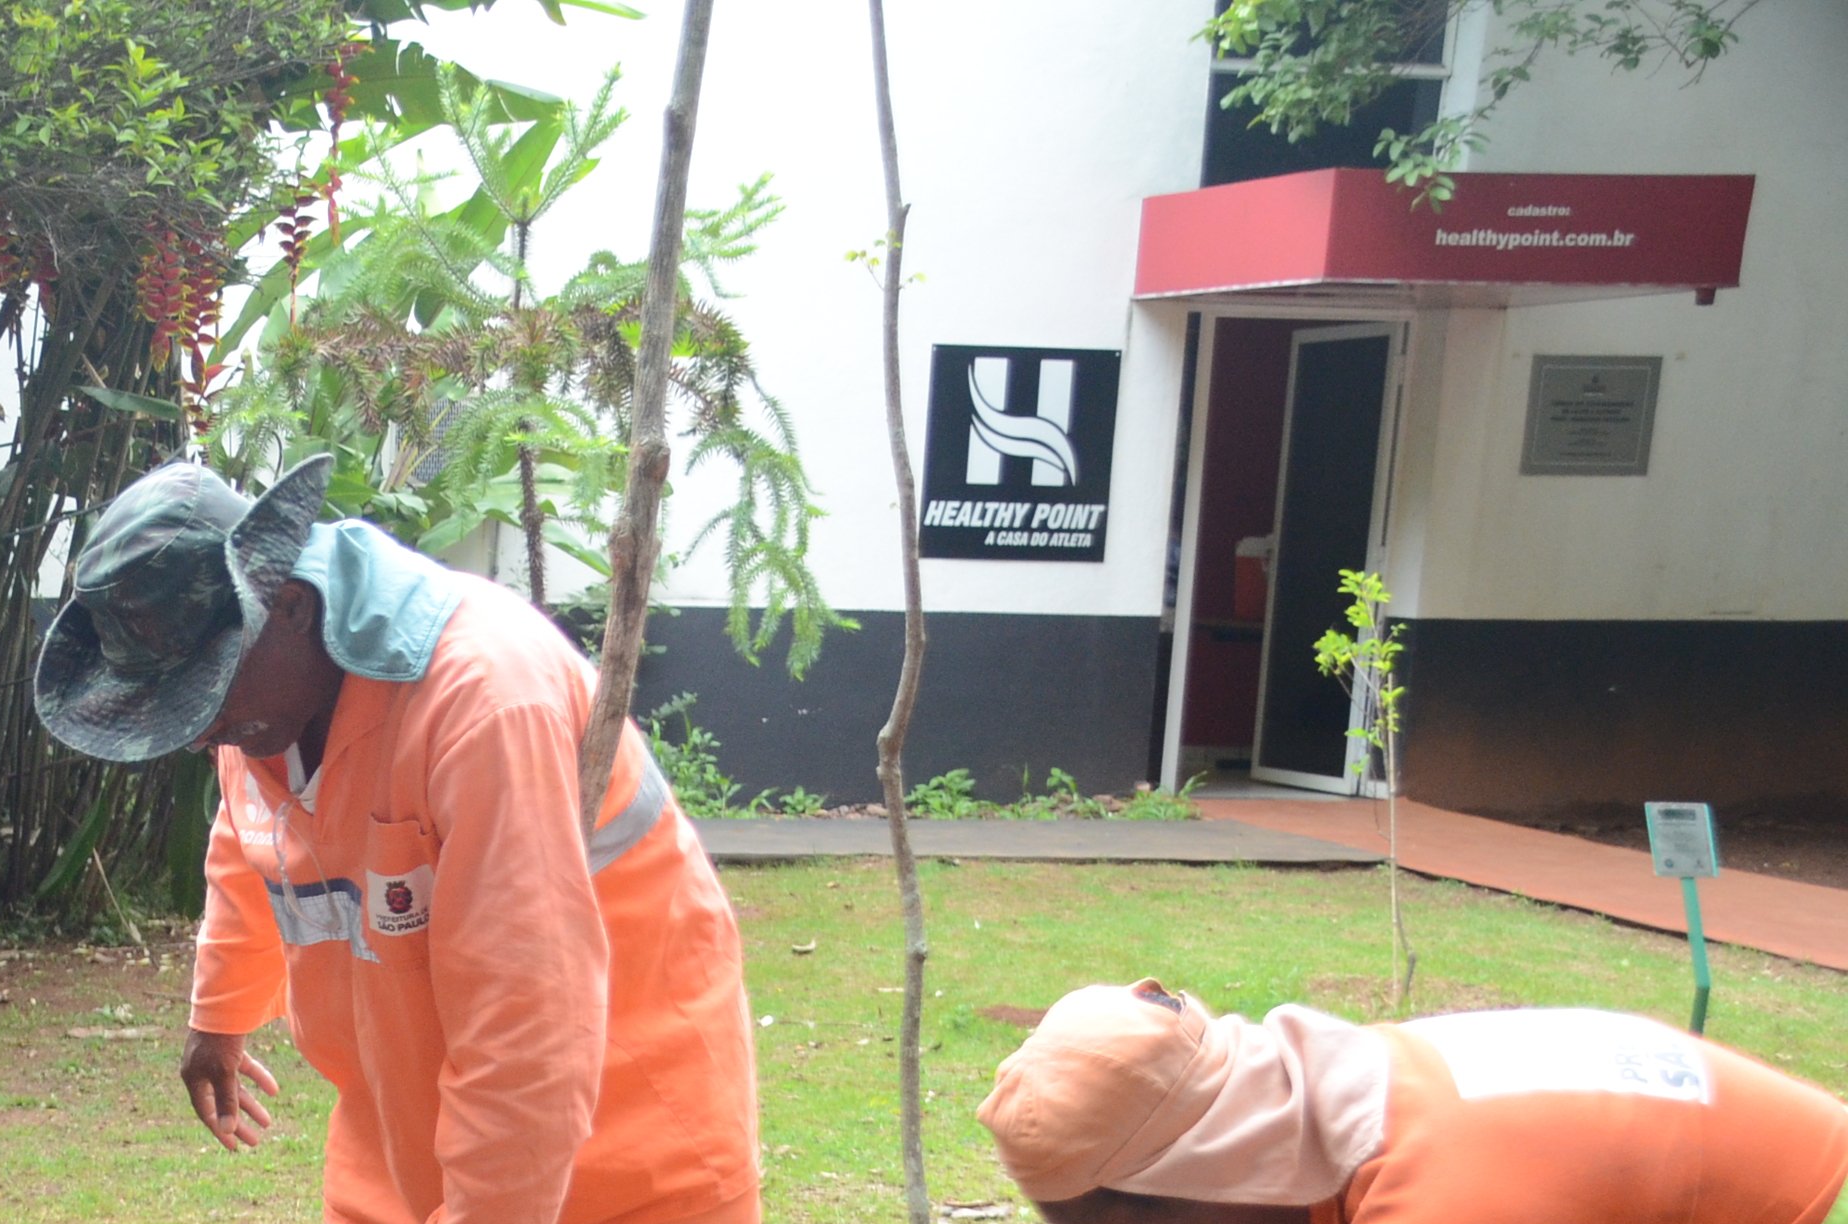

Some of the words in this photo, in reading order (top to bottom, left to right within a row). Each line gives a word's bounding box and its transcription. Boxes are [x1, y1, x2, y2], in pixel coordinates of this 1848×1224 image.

[1507, 204, 1571, 217] cadastro:
[1435, 228, 1635, 250] healthypoint.com.br
[923, 500, 1032, 528] HEALTHY
[1030, 503, 1106, 531] POINT
[984, 531, 996, 546] A
[996, 531, 1029, 547] CASA
[1030, 532, 1049, 548] DO
[1049, 533, 1092, 548] ATLETA
